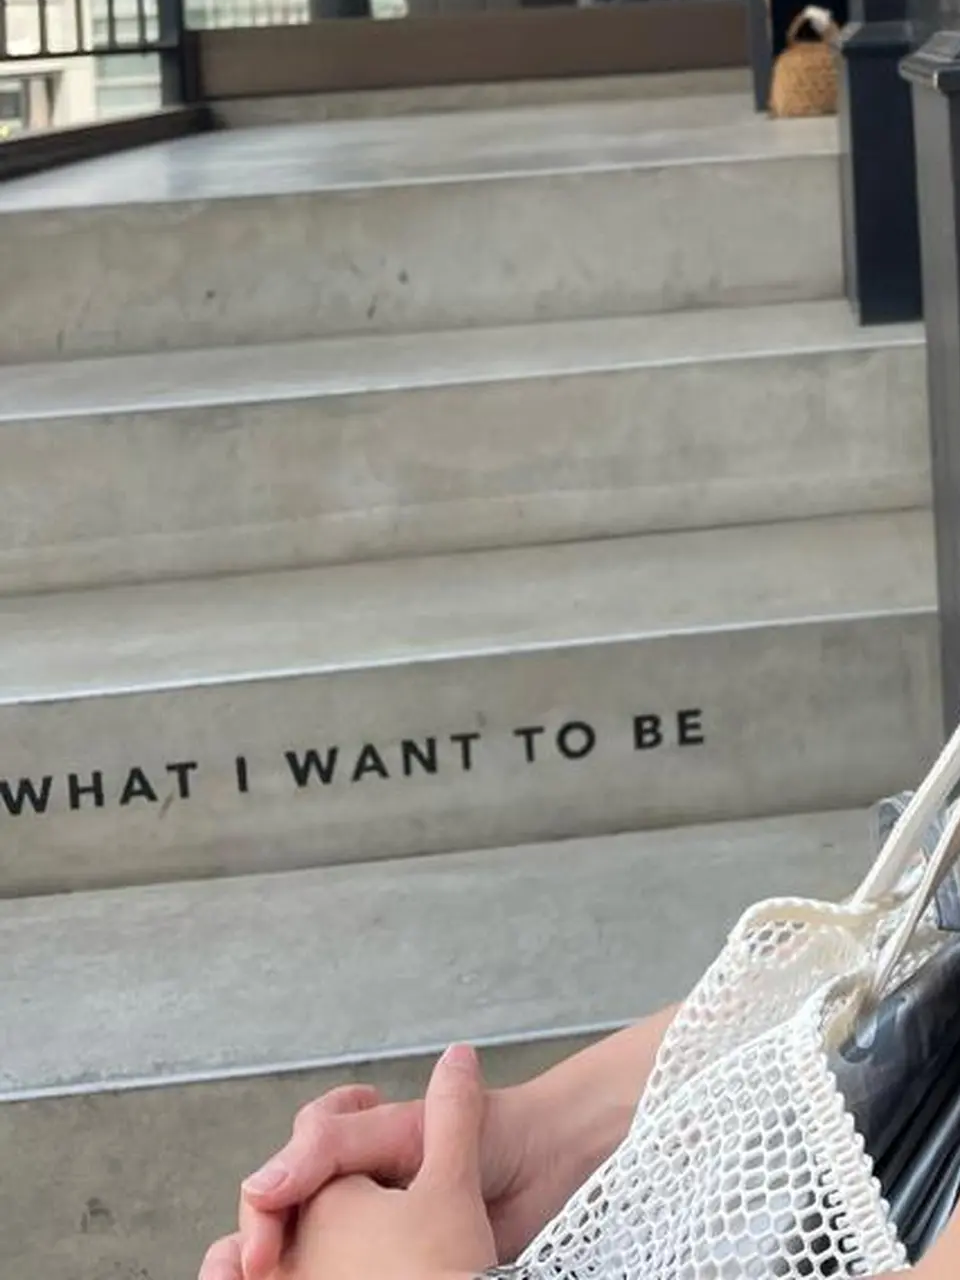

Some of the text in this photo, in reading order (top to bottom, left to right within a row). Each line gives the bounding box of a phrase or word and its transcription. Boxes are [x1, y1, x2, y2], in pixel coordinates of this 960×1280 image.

[0, 708, 706, 816] WHAT I WANT TO BE
